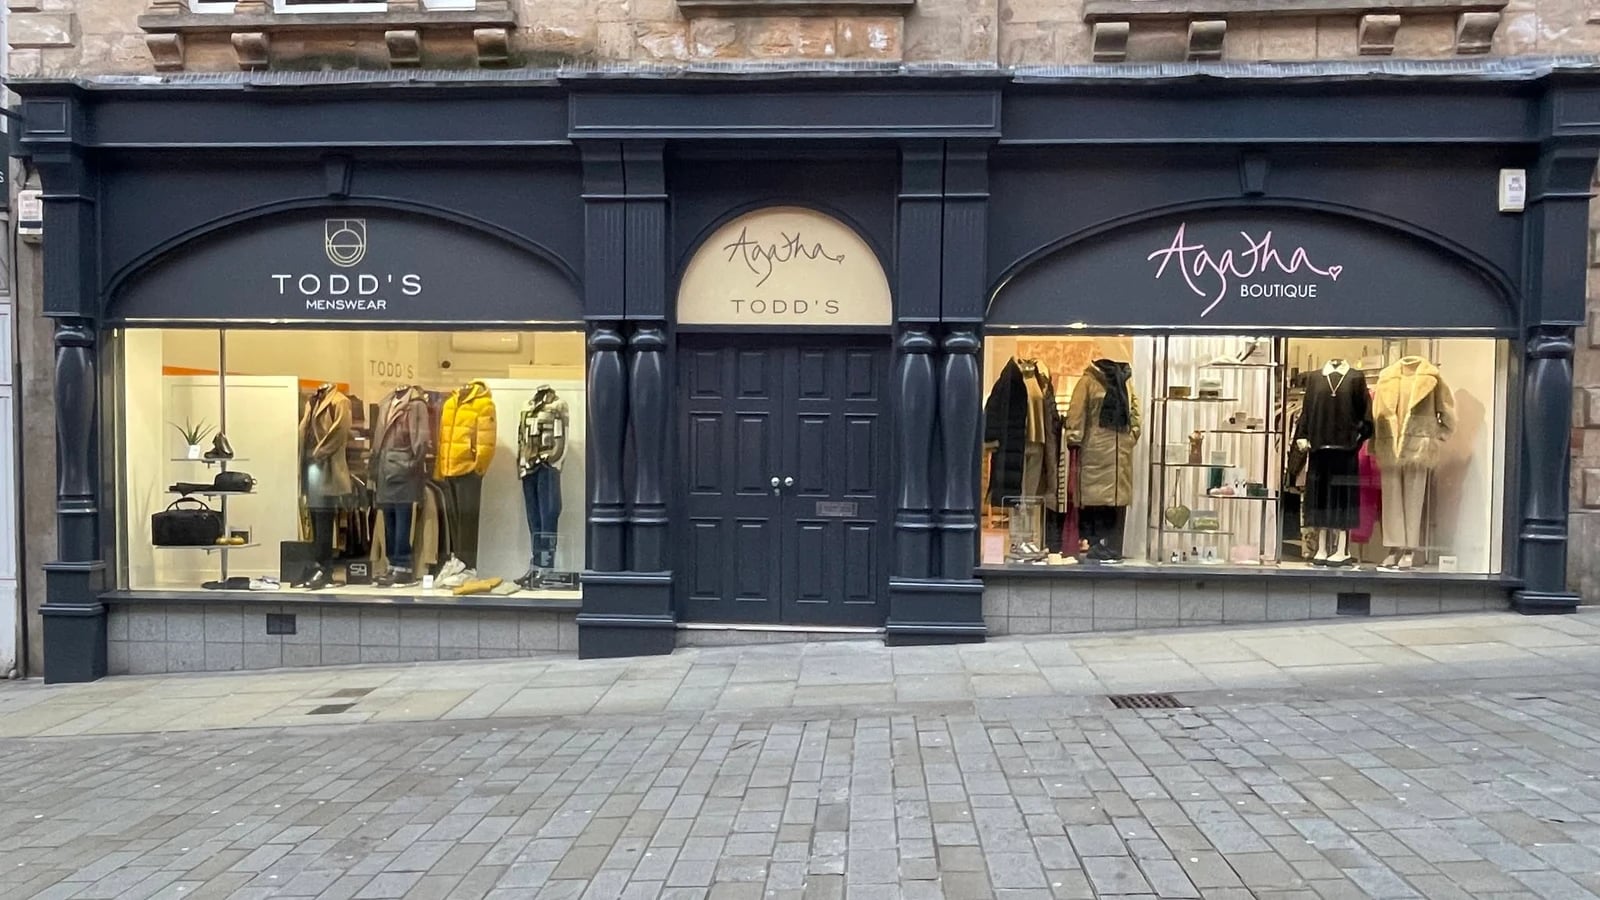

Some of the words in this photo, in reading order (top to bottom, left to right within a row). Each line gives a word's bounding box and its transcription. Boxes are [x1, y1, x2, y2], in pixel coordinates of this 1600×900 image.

[723, 226, 838, 288] Agatha
[1147, 221, 1331, 318] Agatha
[271, 273, 422, 296] TODD'S
[1239, 283, 1318, 299] BOUTIQUE
[305, 299, 388, 310] MENSWEAR
[729, 299, 840, 315] TODD'S
